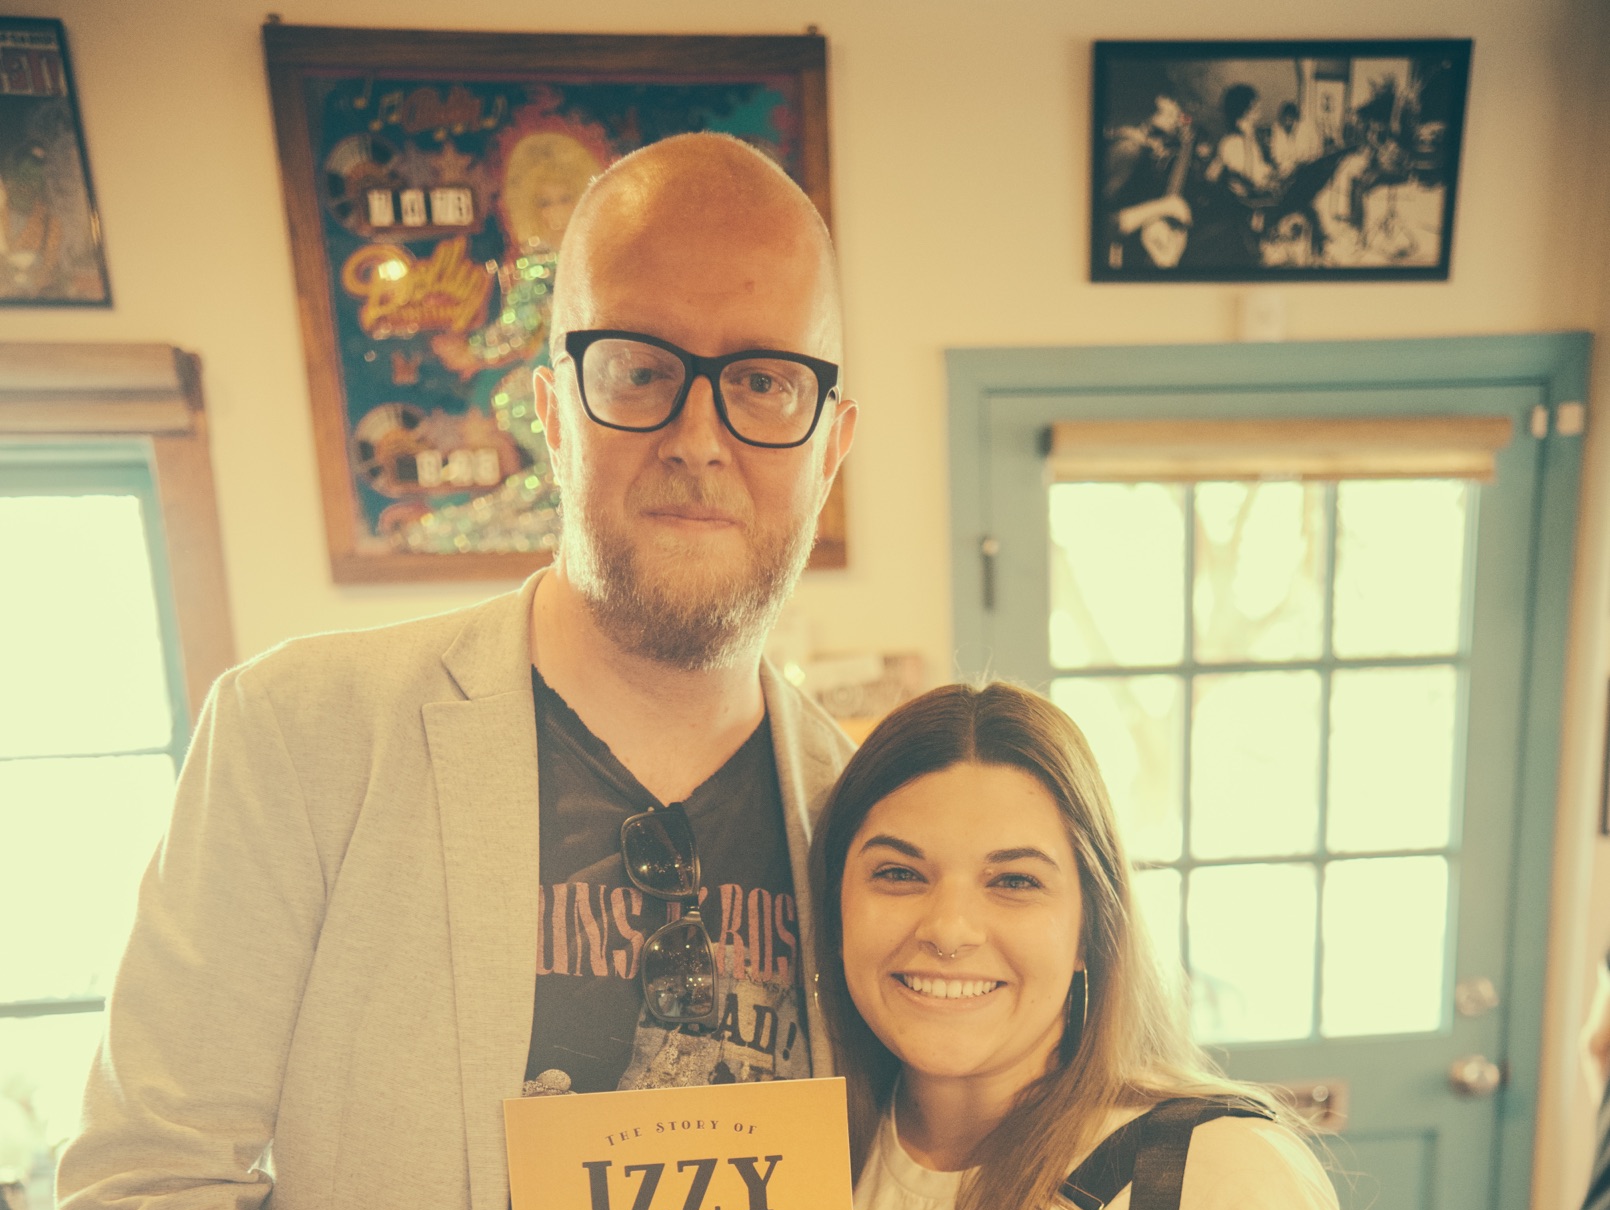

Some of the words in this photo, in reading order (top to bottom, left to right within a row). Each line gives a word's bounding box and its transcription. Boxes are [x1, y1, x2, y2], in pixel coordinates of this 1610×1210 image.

[536, 882, 645, 979] UNS
[714, 883, 797, 982] ROS
[605, 1127, 642, 1146] THE
[656, 1120, 719, 1133] STORY
[733, 1122, 757, 1135] OF
